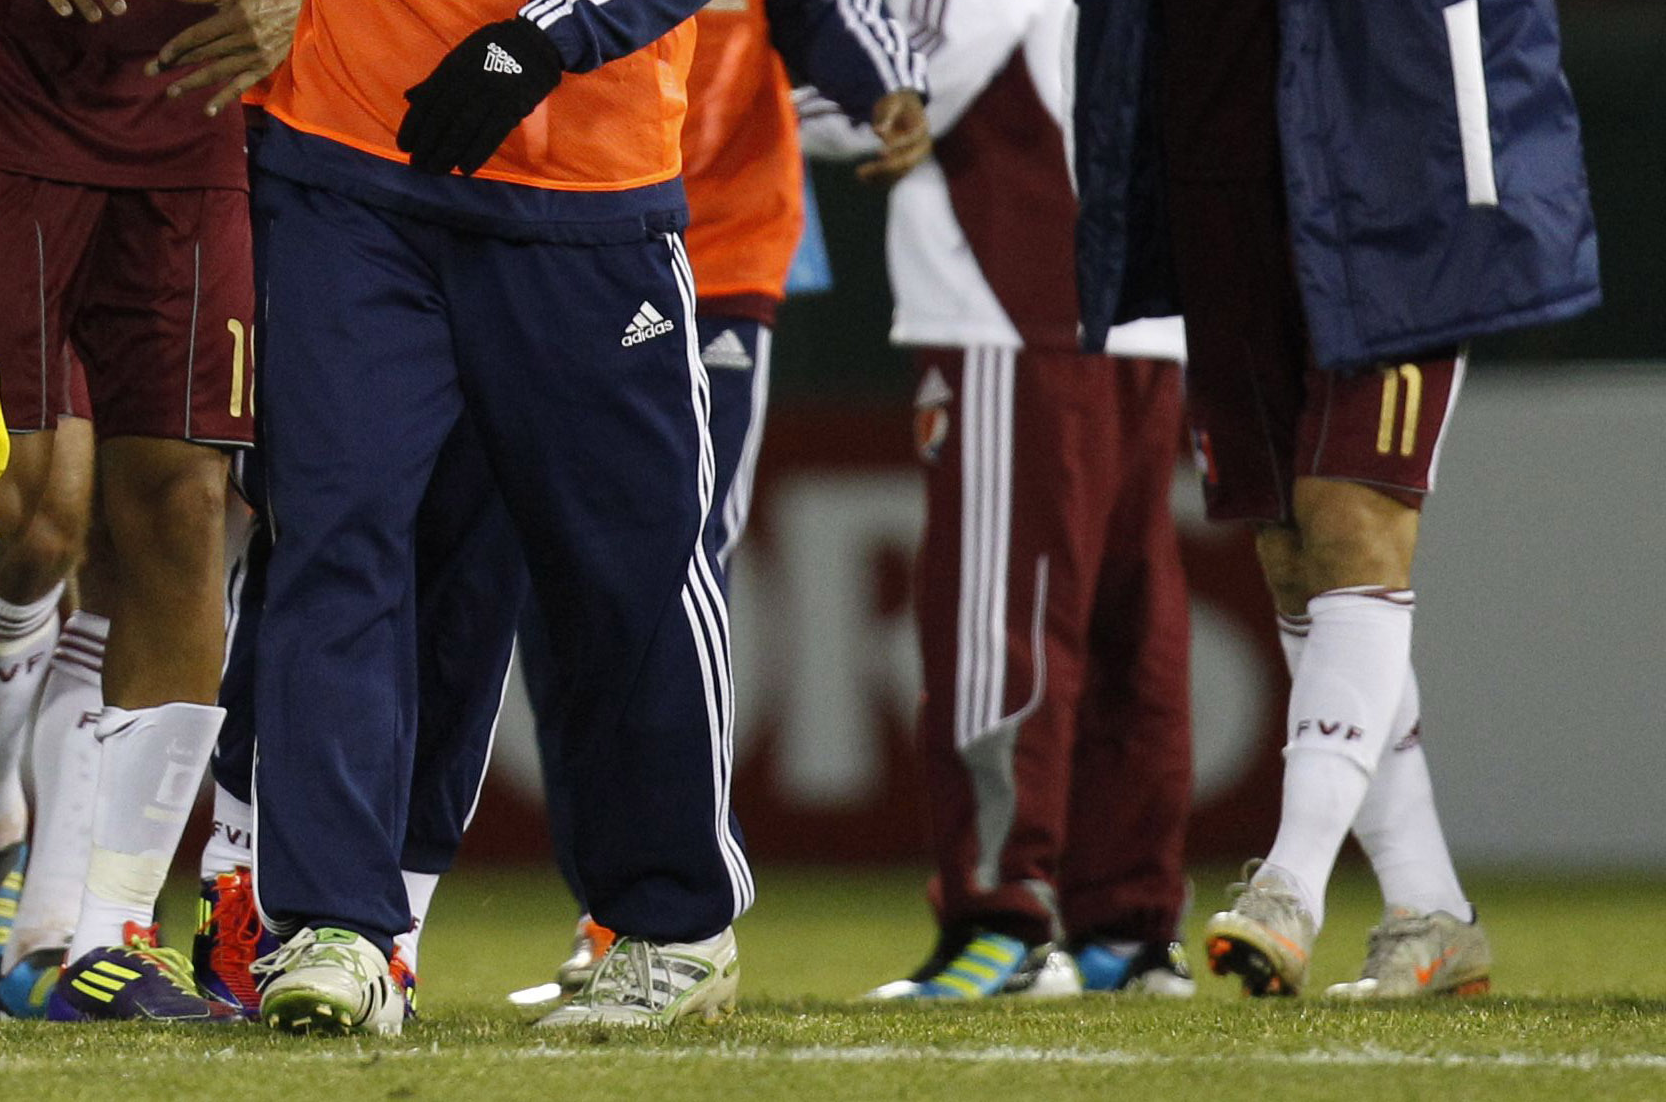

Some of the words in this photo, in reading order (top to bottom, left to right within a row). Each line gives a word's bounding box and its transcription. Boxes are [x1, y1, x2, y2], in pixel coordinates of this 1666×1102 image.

[620, 319, 675, 348] adidas
[227, 318, 255, 418] 1
[1376, 363, 1423, 457] 11
[1296, 719, 1365, 742] FVF
